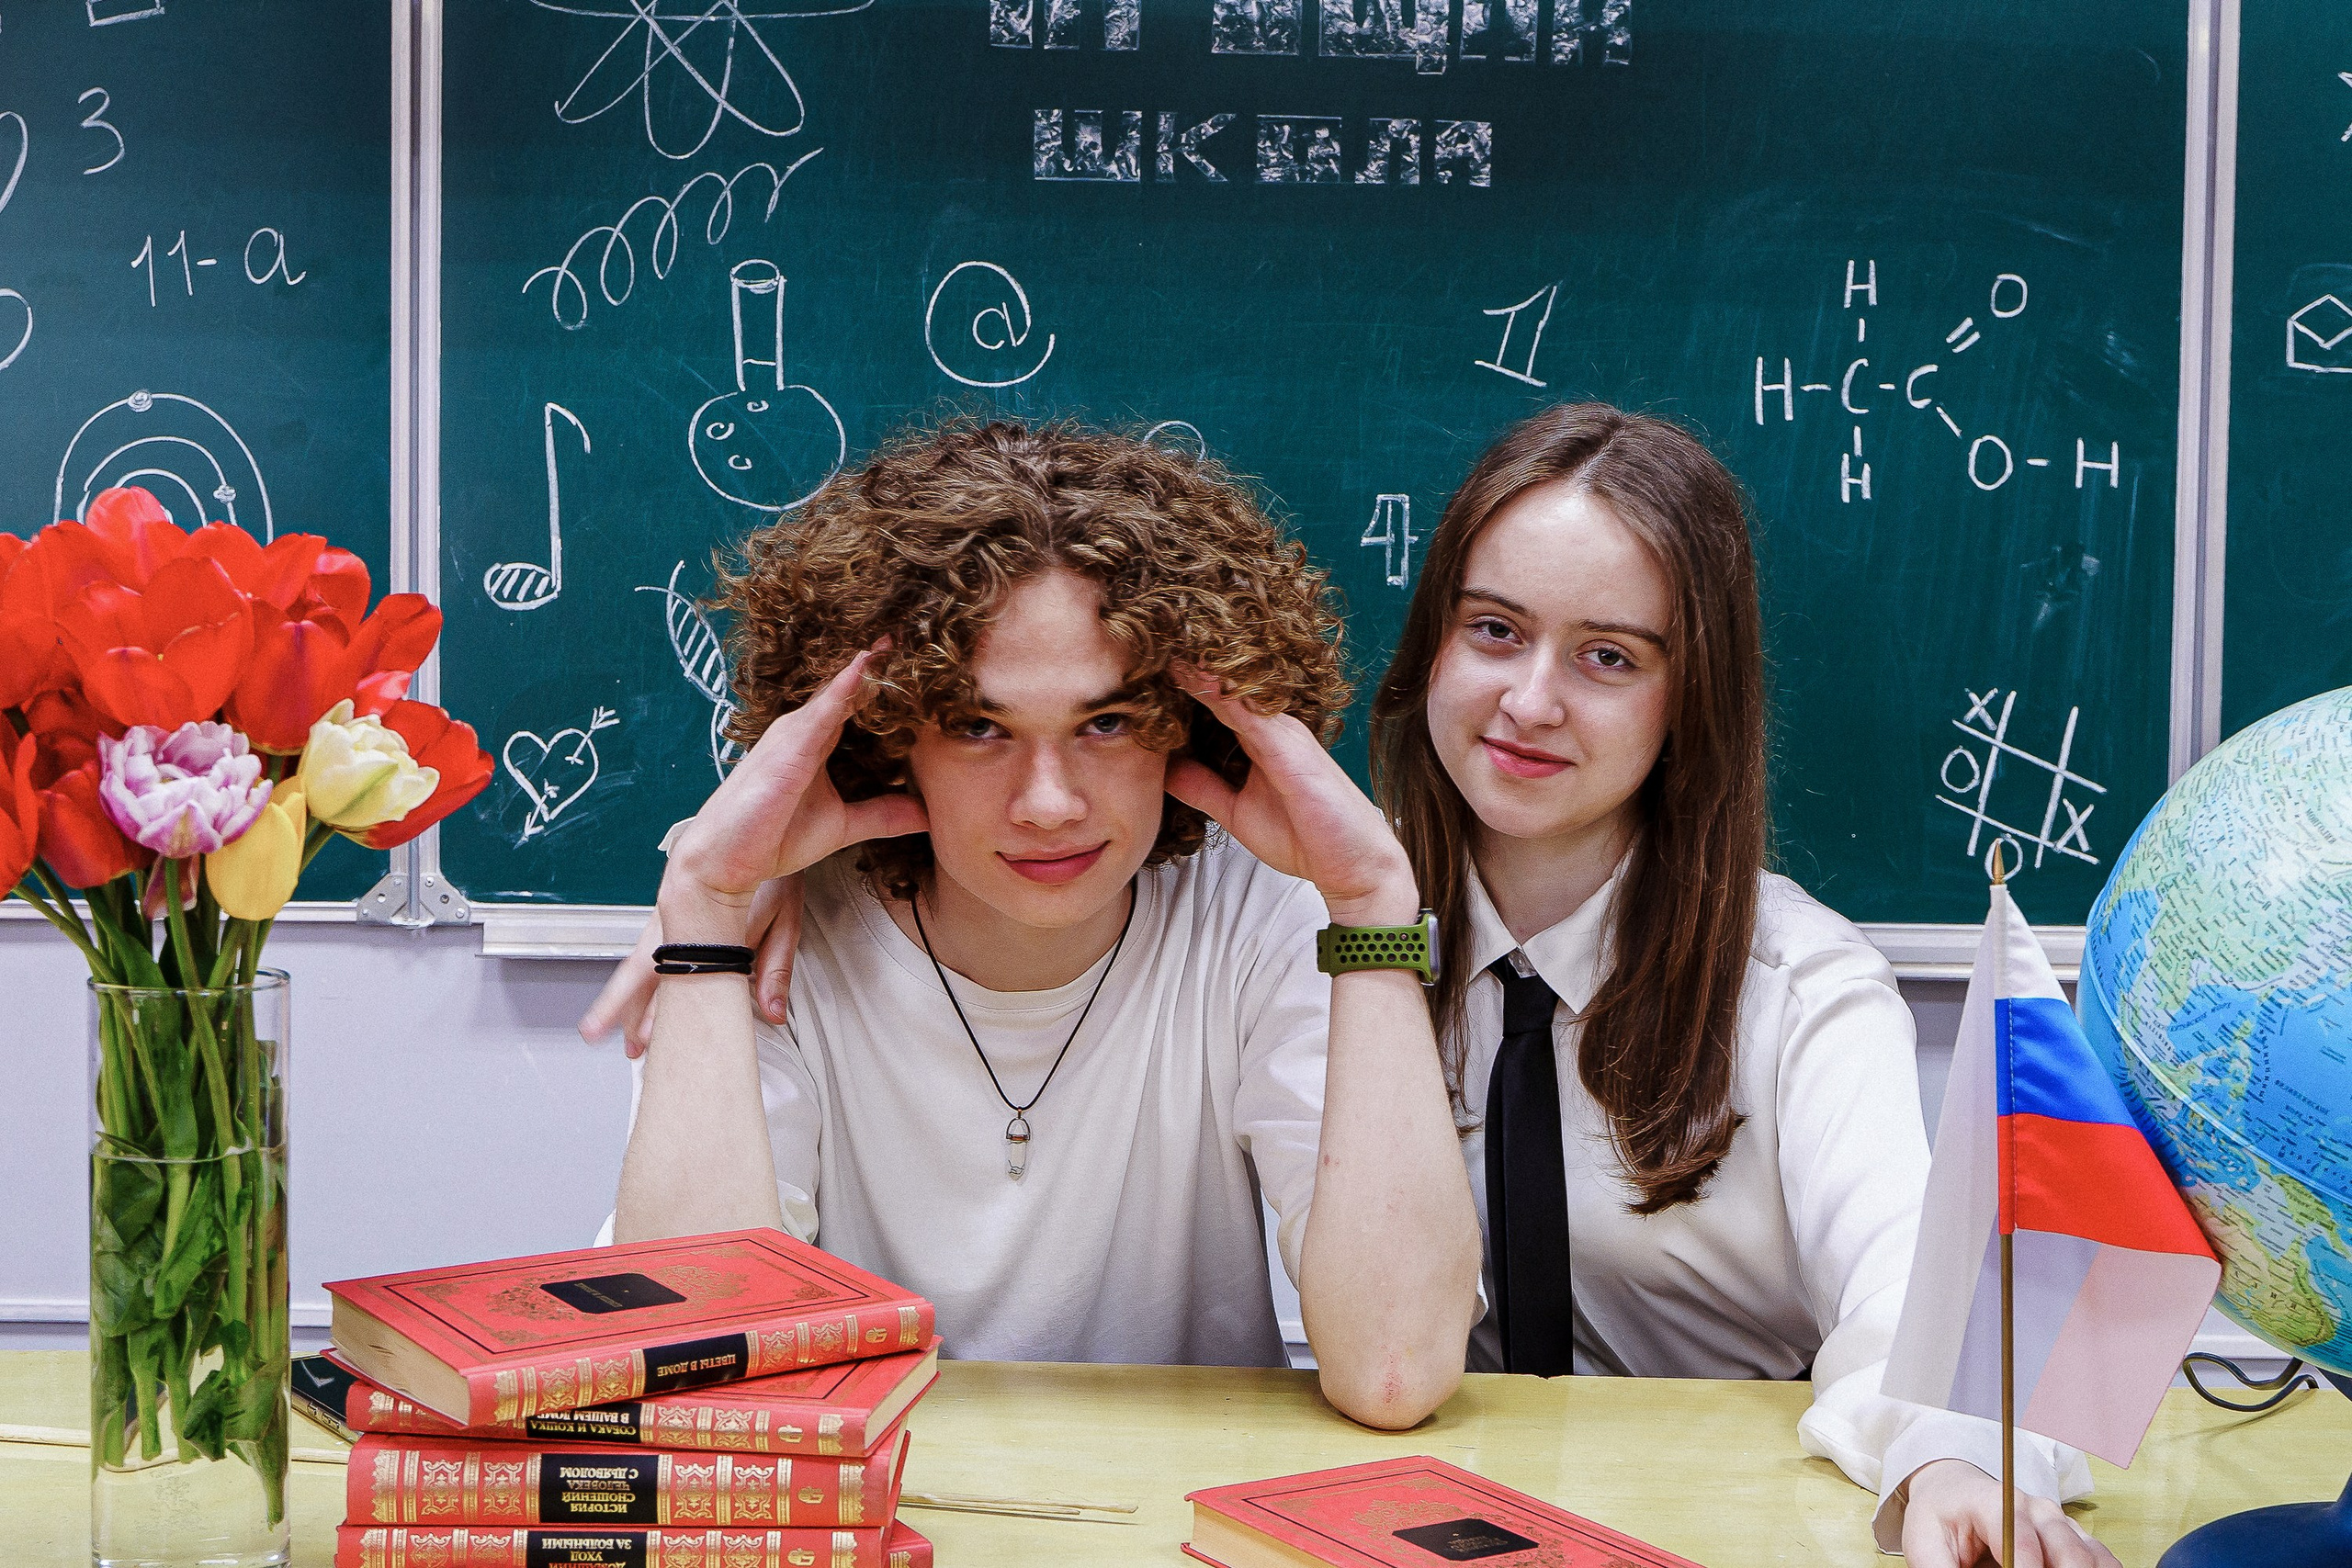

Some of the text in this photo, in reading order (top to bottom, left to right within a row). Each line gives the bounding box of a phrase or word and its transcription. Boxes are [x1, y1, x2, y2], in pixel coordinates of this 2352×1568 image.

[78, 86, 125, 175] 3
[1034, 108, 1492, 187] ШКОЛА
[1361, 493, 1419, 589] 4
[657, 1354, 736, 1377] ЦВЕТЫ В ДОМЕ
[573, 1411, 618, 1423] ВАШЕМ
[621, 1413, 629, 1424] В
[529, 1420, 637, 1436] СОБАКА И КОШКА
[560, 1467, 639, 1479] С ДЬЯВОЛОМ
[566, 1480, 630, 1491] ЧЕЛОВЕКА
[561, 1491, 637, 1503] СНОШЕНИЙ
[570, 1503, 628, 1513] ИСТОРИЯ
[541, 1538, 633, 1550] ЗА БОЛЬНЫМИ
[570, 1551, 604, 1562] УХОД
